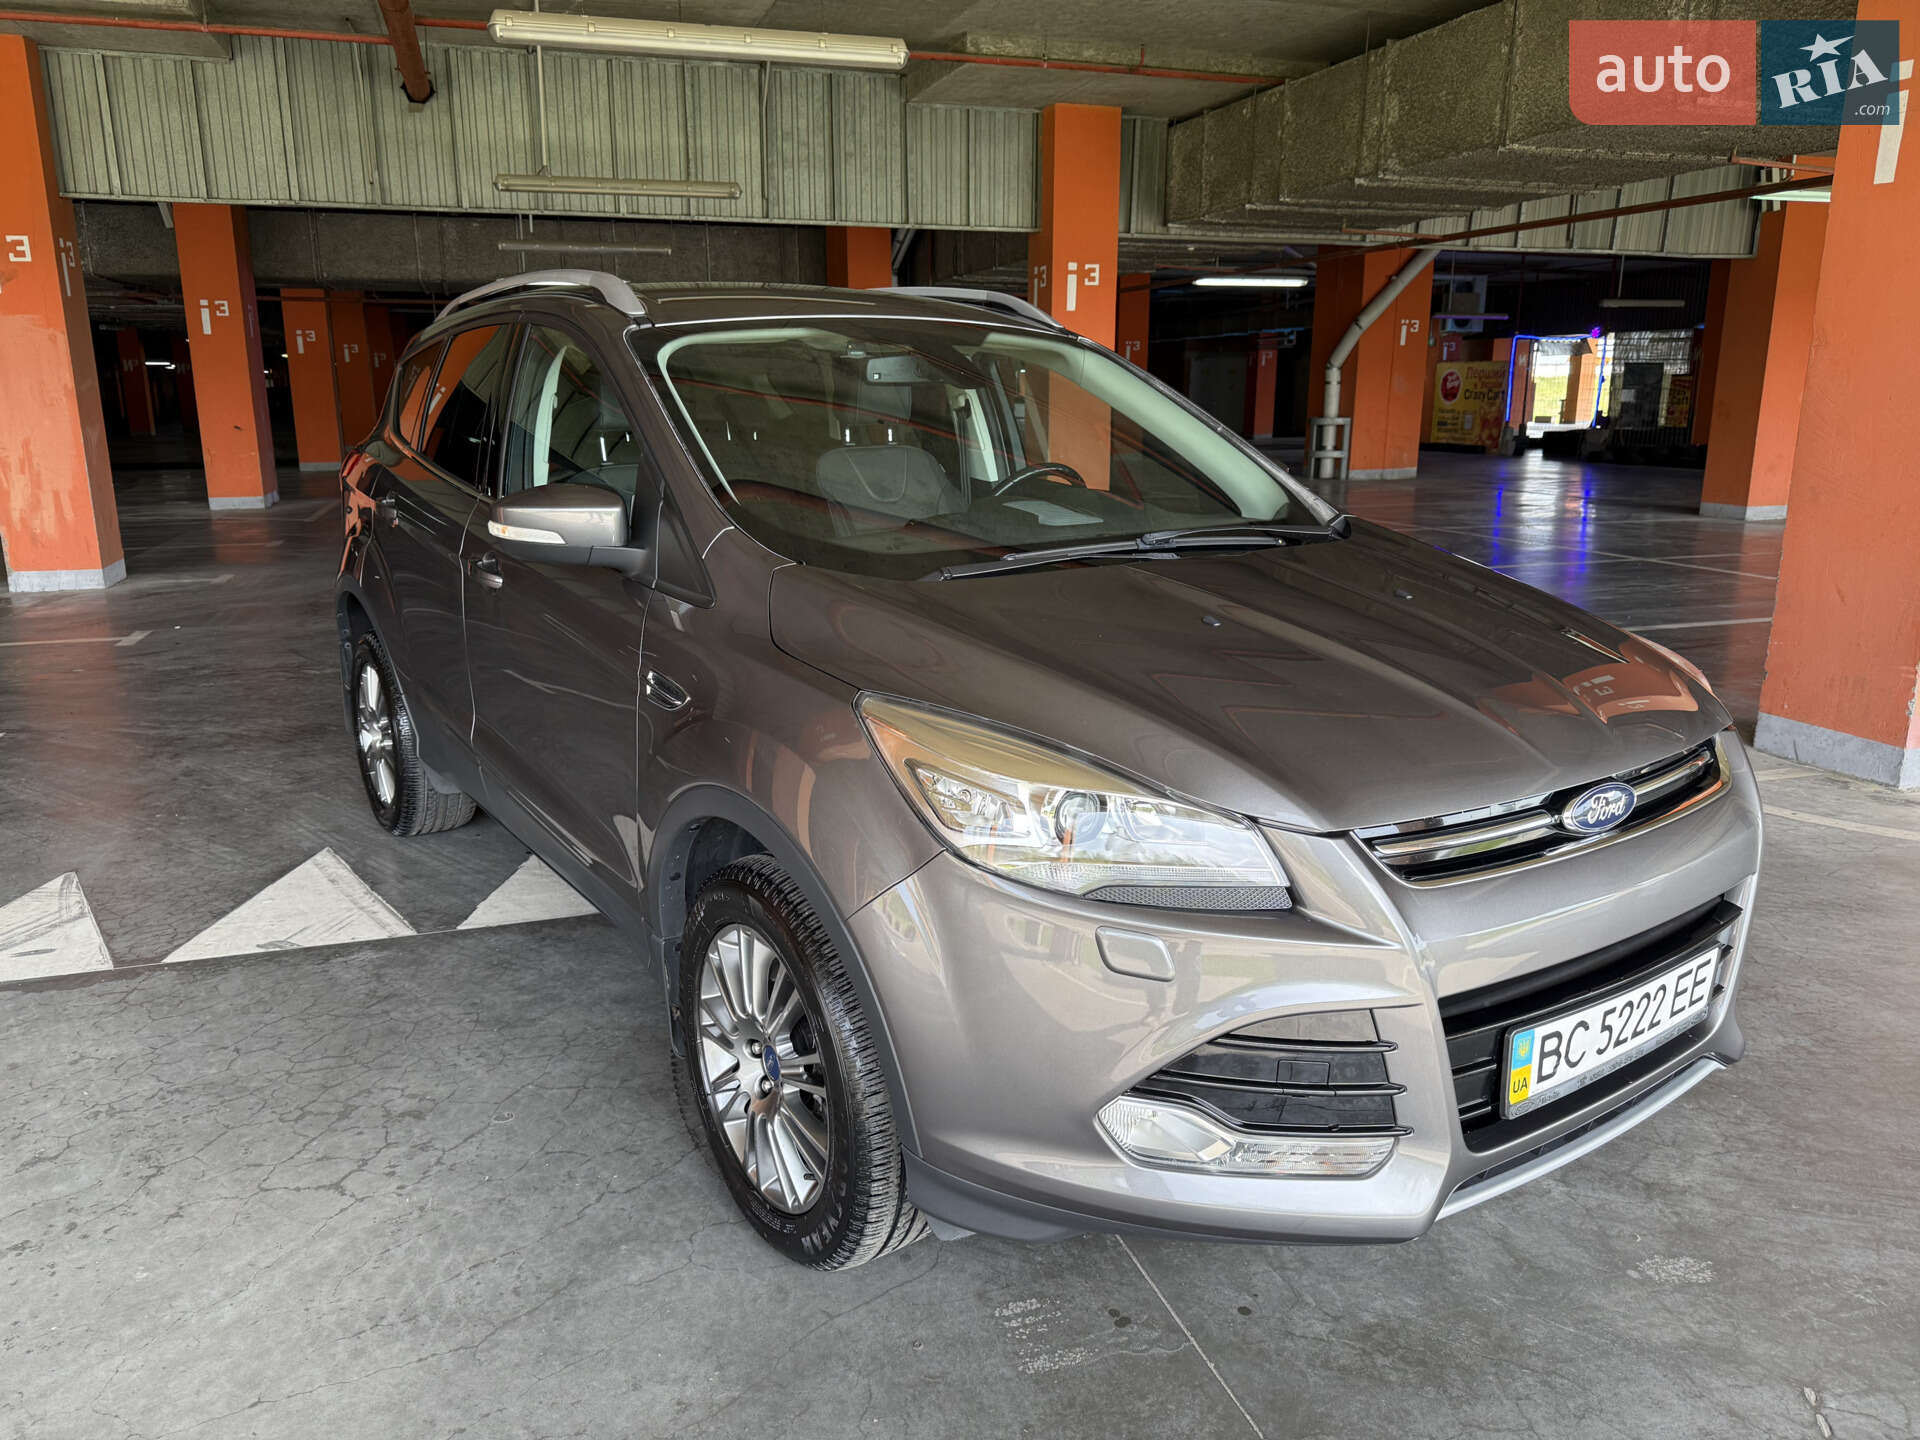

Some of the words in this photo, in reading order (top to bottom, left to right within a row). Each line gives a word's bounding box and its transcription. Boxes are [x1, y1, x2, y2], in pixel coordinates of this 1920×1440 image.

[0, 234, 32, 262] 3
[1587, 790, 1626, 824] Ford
[1537, 1020, 1590, 1085] BC
[1595, 983, 1667, 1055] 5222
[1669, 958, 1712, 1018] EE
[1512, 1077, 1529, 1094] UA
